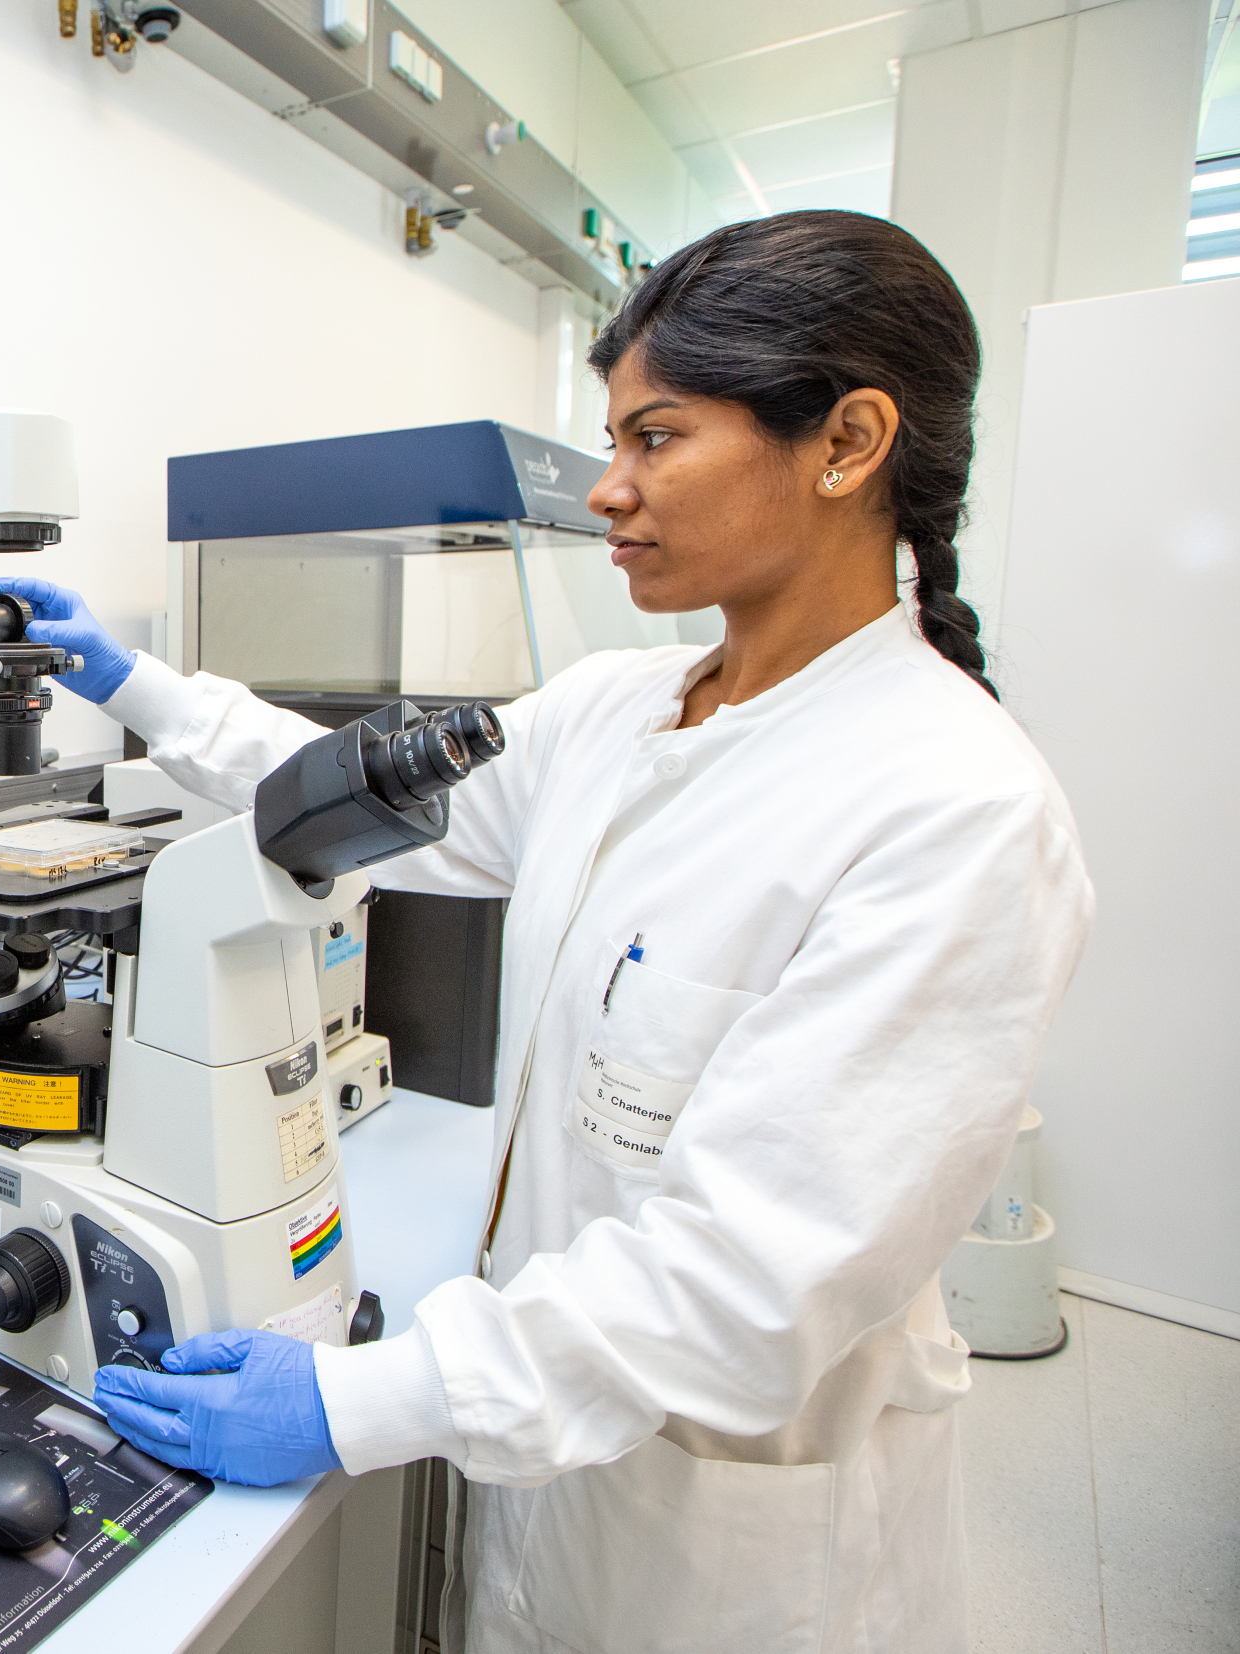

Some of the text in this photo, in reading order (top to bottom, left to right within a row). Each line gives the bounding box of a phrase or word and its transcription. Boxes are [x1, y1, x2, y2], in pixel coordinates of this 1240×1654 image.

[290, 1055, 307, 1072] Nikon
[589, 1051, 604, 1070] MHH
[288, 1063, 311, 1080] ECLIPSE
[297, 1074, 306, 1086] Ti
[2, 1077, 36, 1086] WARNING
[620, 1082, 641, 1093] Hochschule
[282, 1099, 318, 1124] Position Filter
[597, 1088, 672, 1121] S. Chatterjee
[289, 1215, 307, 1230] Objektive
[97, 1241, 128, 1262] Nikon
[90, 1250, 134, 1273] ECLIPSE
[112, 1302, 120, 1310] ON
[290, 1316, 301, 1329] you
[304, 1305, 322, 1318] change
[88, 1481, 173, 1554] www.nikoninstruments.eu
[0, 1635, 16, 1647] Weg
[36, 1592, 64, 1621] Düsseldorf
[94, 1561, 104, 1569] 214
[103, 1551, 114, 1560] Fax:
